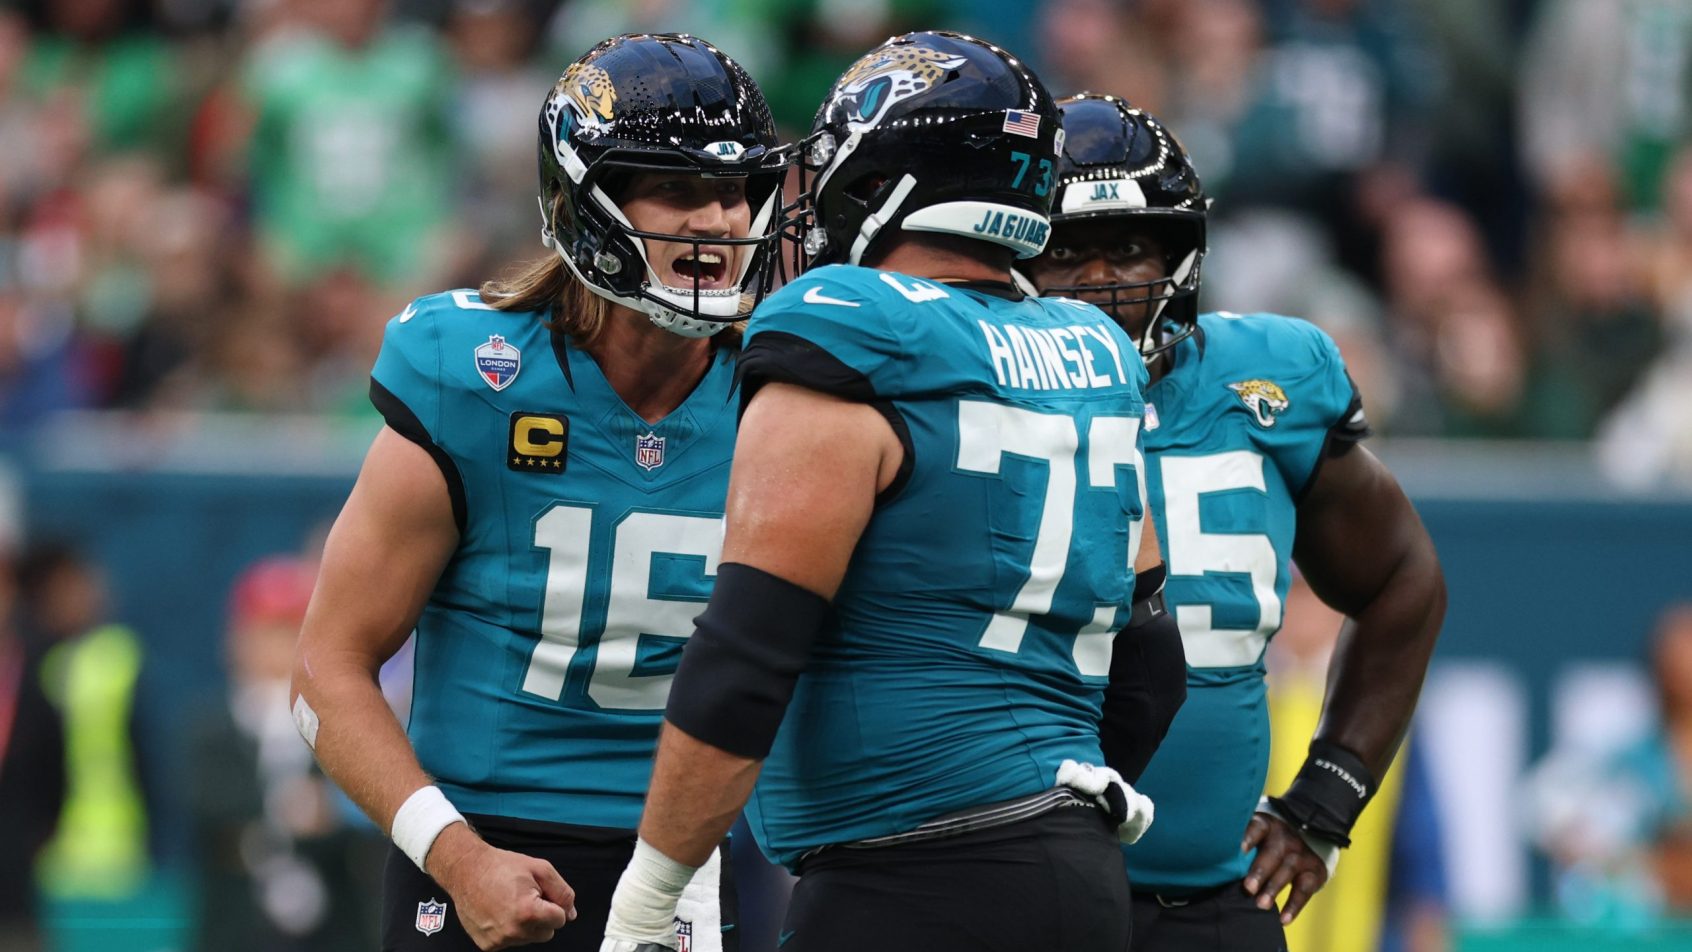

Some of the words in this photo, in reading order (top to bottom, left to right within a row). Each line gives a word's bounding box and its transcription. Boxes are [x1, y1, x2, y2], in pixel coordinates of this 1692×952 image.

[717, 143, 737, 155] JAX
[1011, 151, 1053, 197] 73
[1090, 183, 1120, 200] JAX
[480, 360, 516, 368] LONDON
[978, 320, 1128, 390] HAINSEY
[514, 416, 564, 457] C
[640, 449, 661, 464] NFL
[957, 400, 1148, 677] 73
[522, 505, 727, 710] 16
[420, 914, 441, 929] NFL
